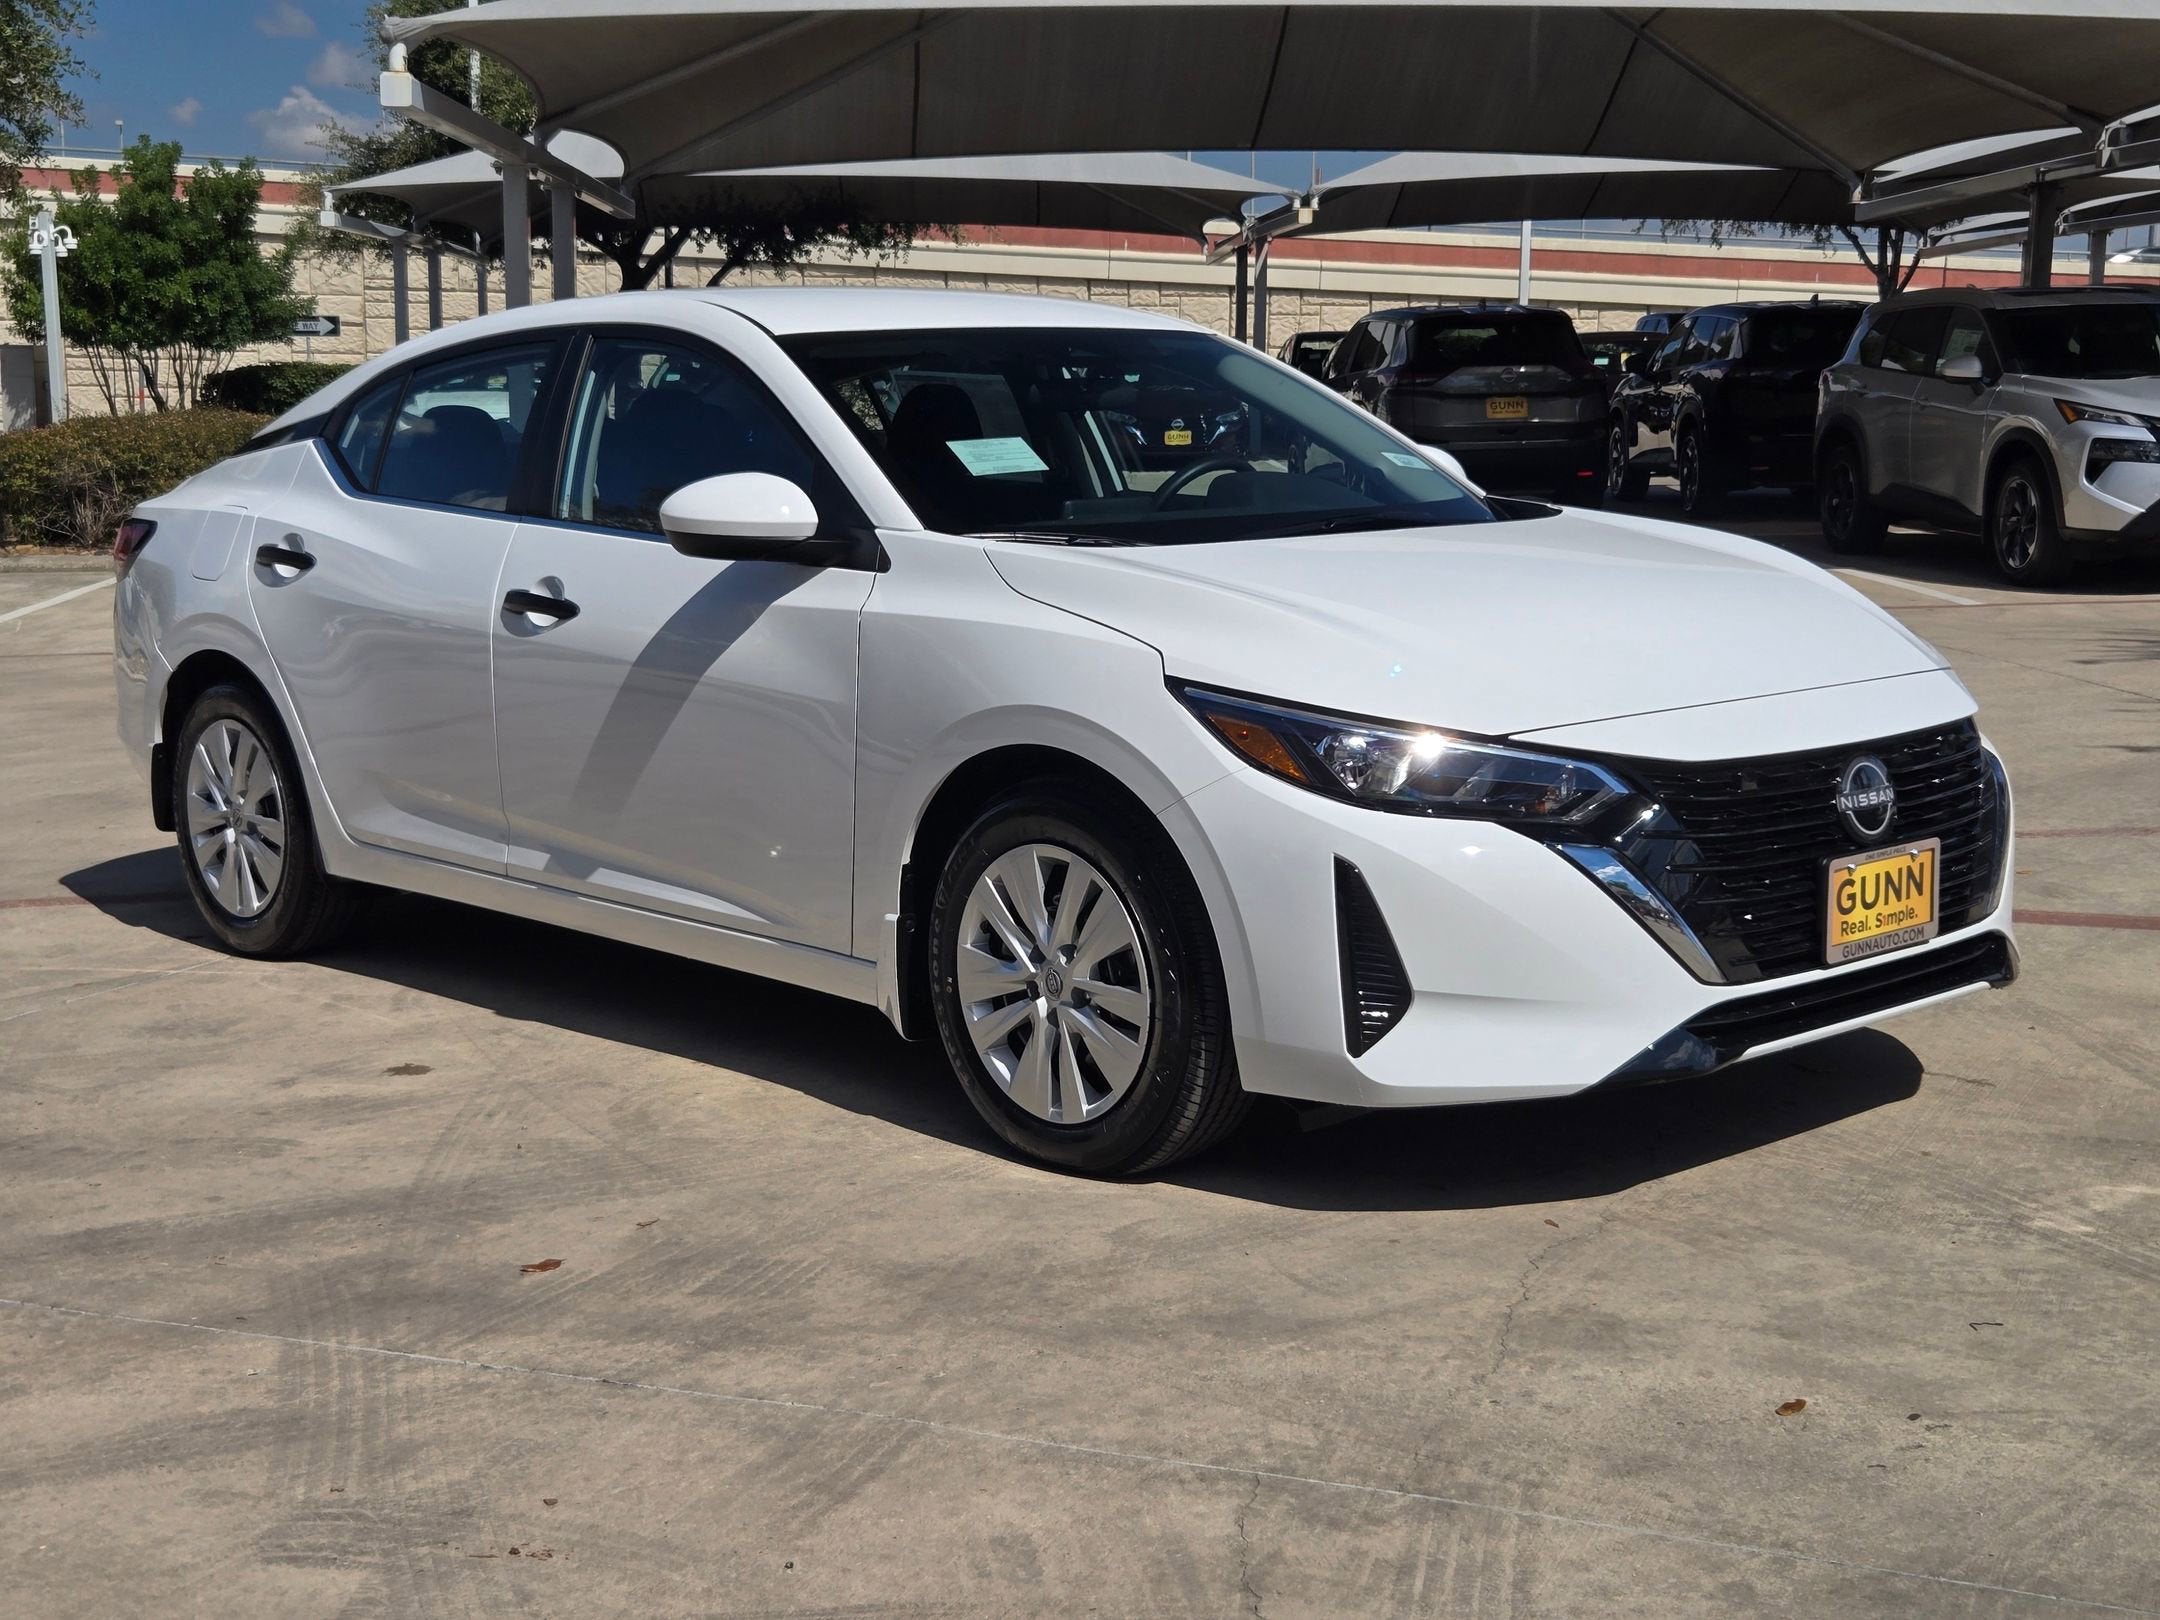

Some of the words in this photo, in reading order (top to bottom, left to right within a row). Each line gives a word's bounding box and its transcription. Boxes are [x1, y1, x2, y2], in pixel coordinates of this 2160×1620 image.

[302, 322, 319, 330] WAY
[1490, 401, 1524, 410] GUNN
[1840, 788, 1894, 809] NISSAN
[1836, 862, 1924, 916] GUNN
[1840, 915, 1872, 937] Real.
[1842, 927, 1925, 958] GUNNAUTO.COM
